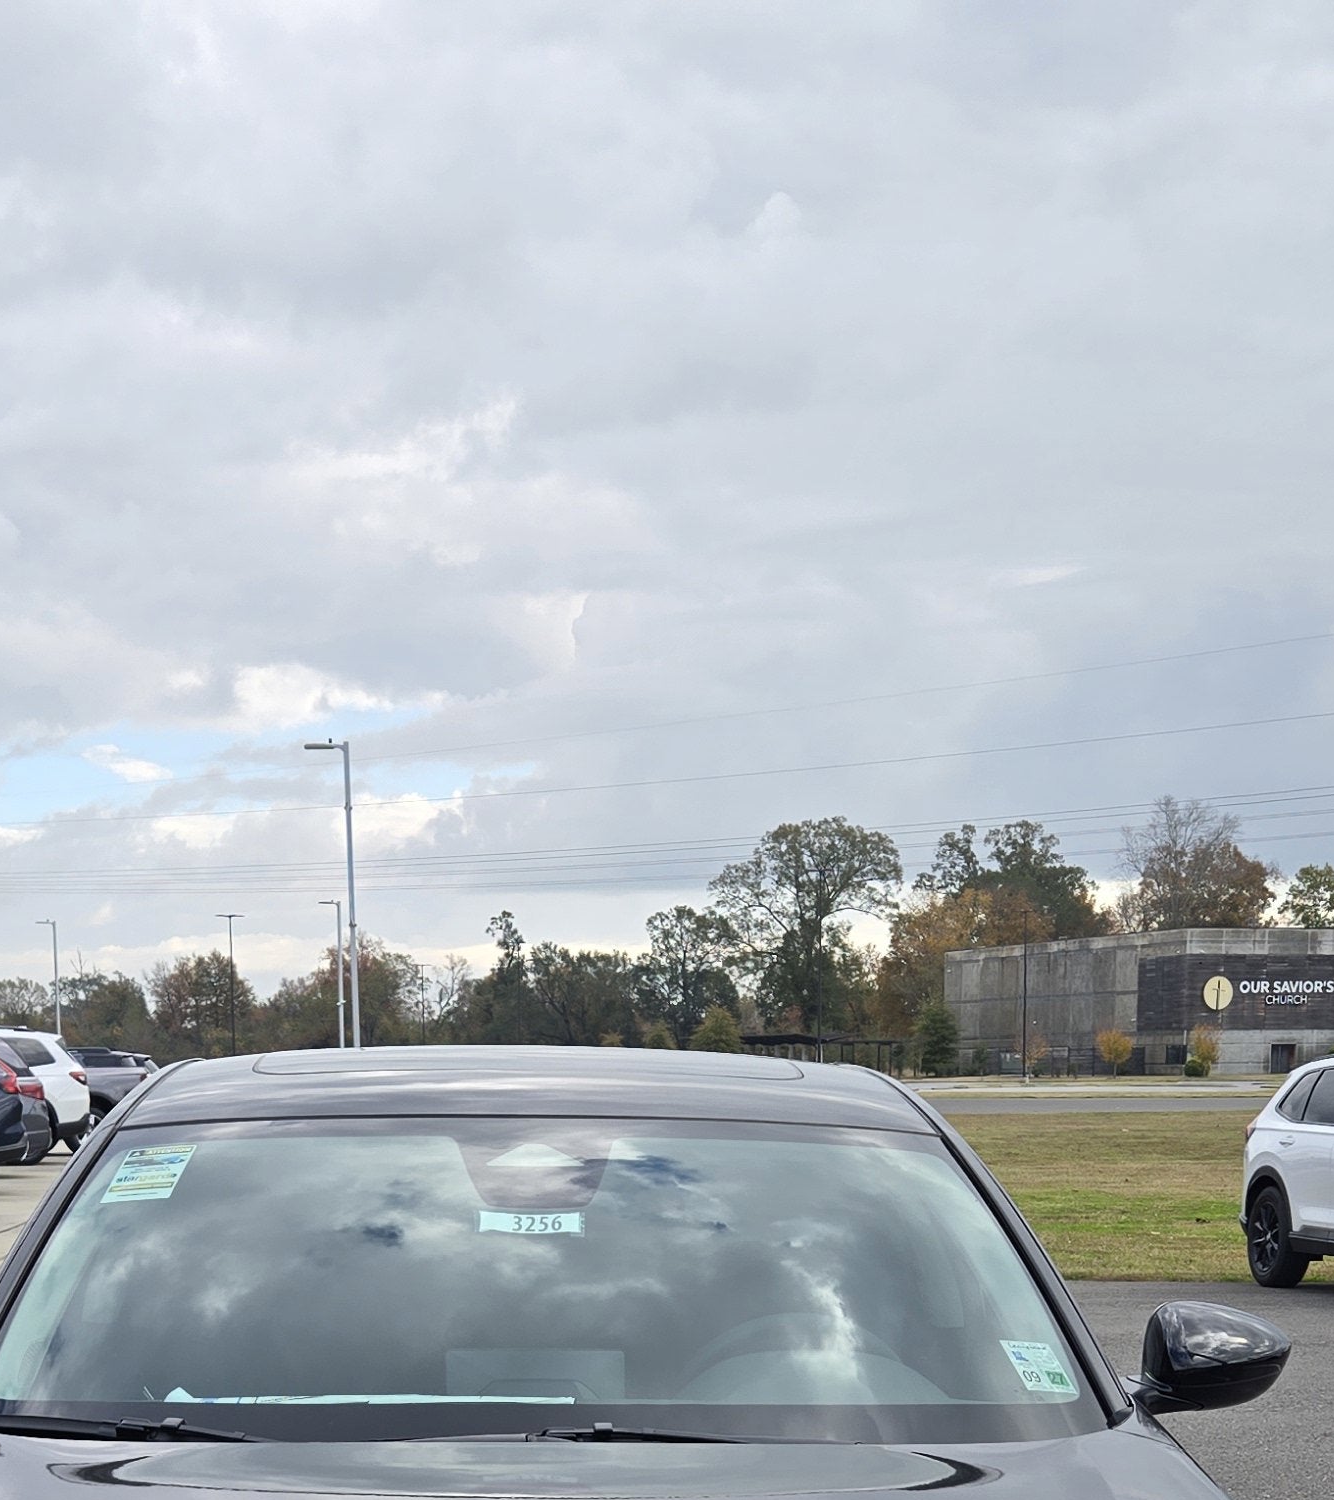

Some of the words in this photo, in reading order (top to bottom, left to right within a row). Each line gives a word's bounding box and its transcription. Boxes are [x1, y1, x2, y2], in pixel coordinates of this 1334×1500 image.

[1239, 981, 1270, 993] OUR
[1273, 981, 1334, 993] SAVIOR'S
[1266, 995, 1308, 1005] CHURCH
[512, 1215, 562, 1232] 3256
[1023, 1370, 1041, 1383] 09
